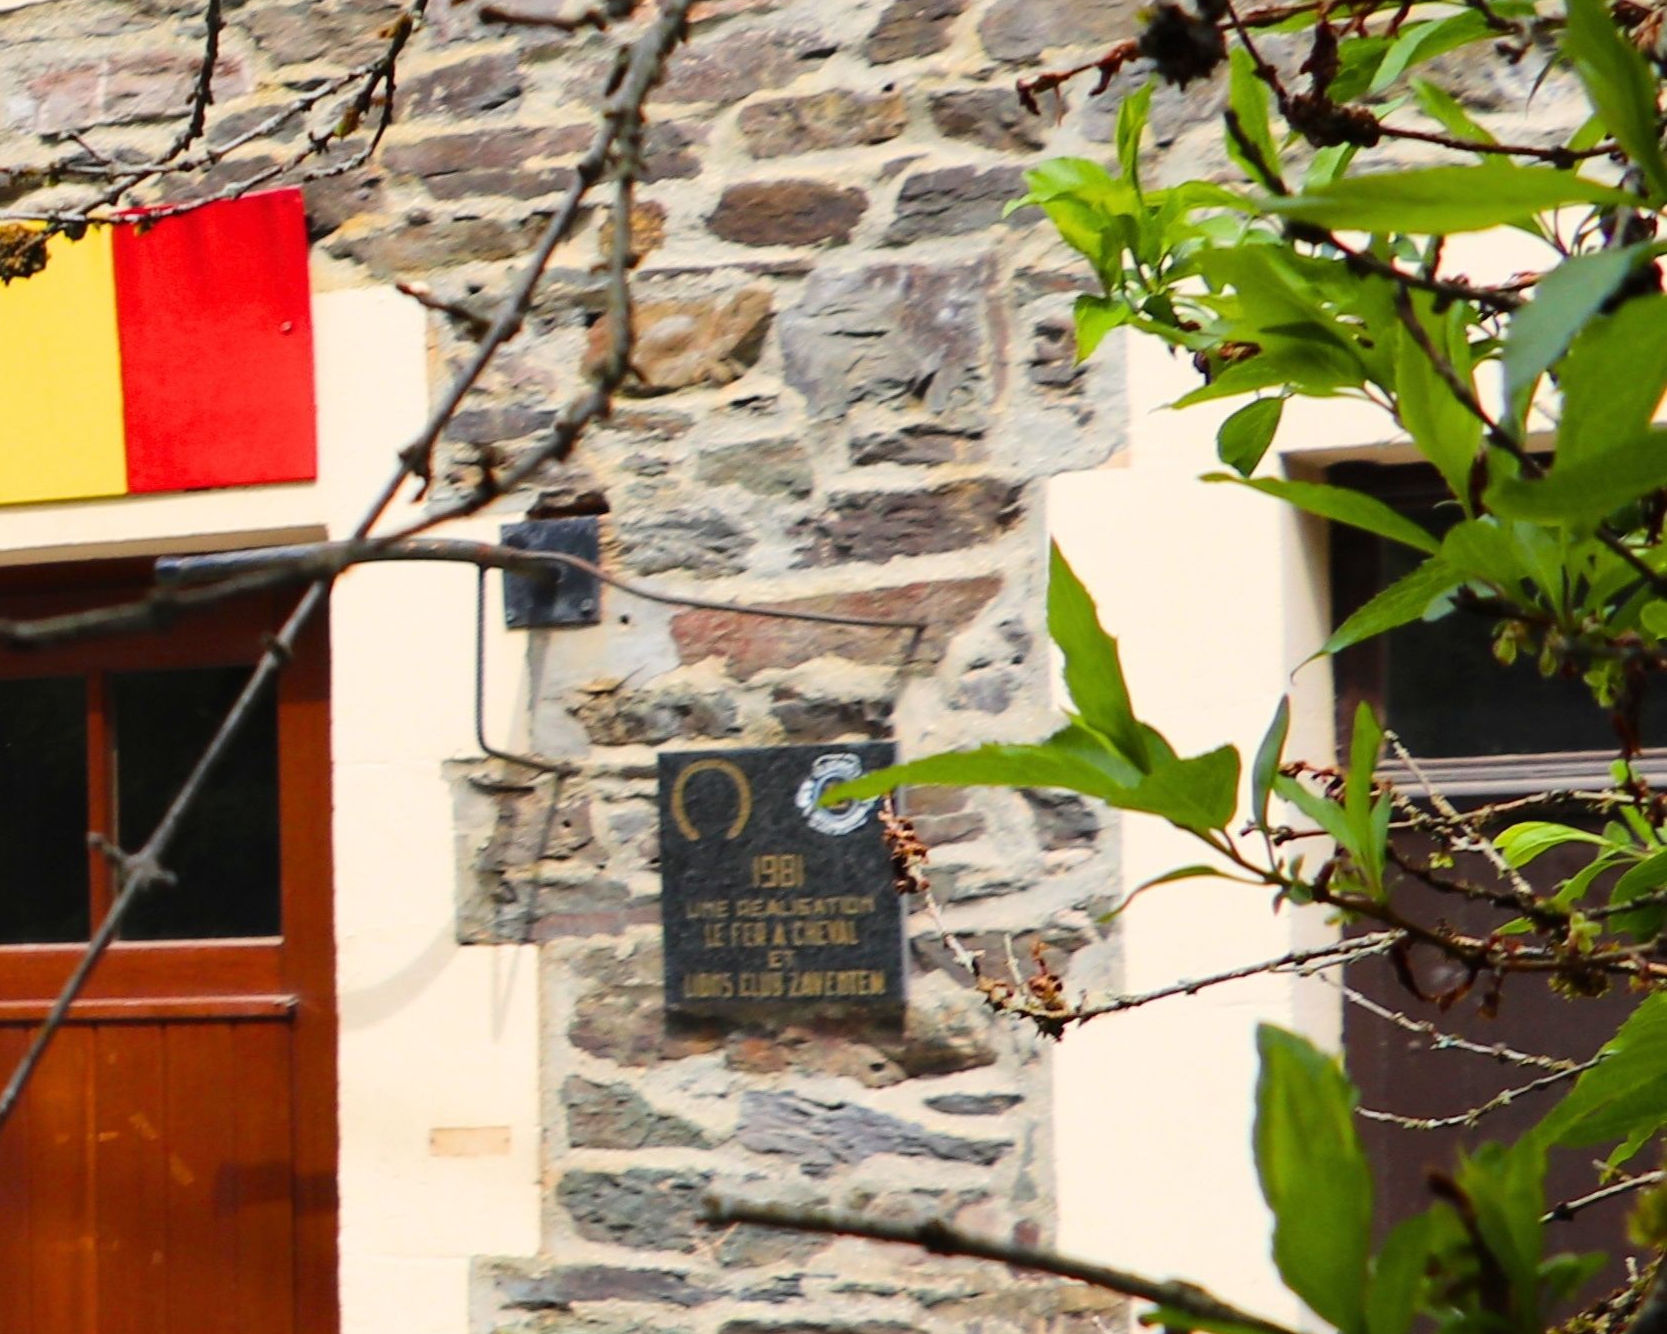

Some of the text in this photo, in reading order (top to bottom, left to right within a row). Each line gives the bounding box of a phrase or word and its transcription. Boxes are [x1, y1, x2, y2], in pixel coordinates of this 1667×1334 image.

[752, 853, 805, 888] 1981
[685, 899, 730, 919] UNE
[704, 919, 859, 947] LE FER A CHEVAL
[767, 949, 795, 968] ET
